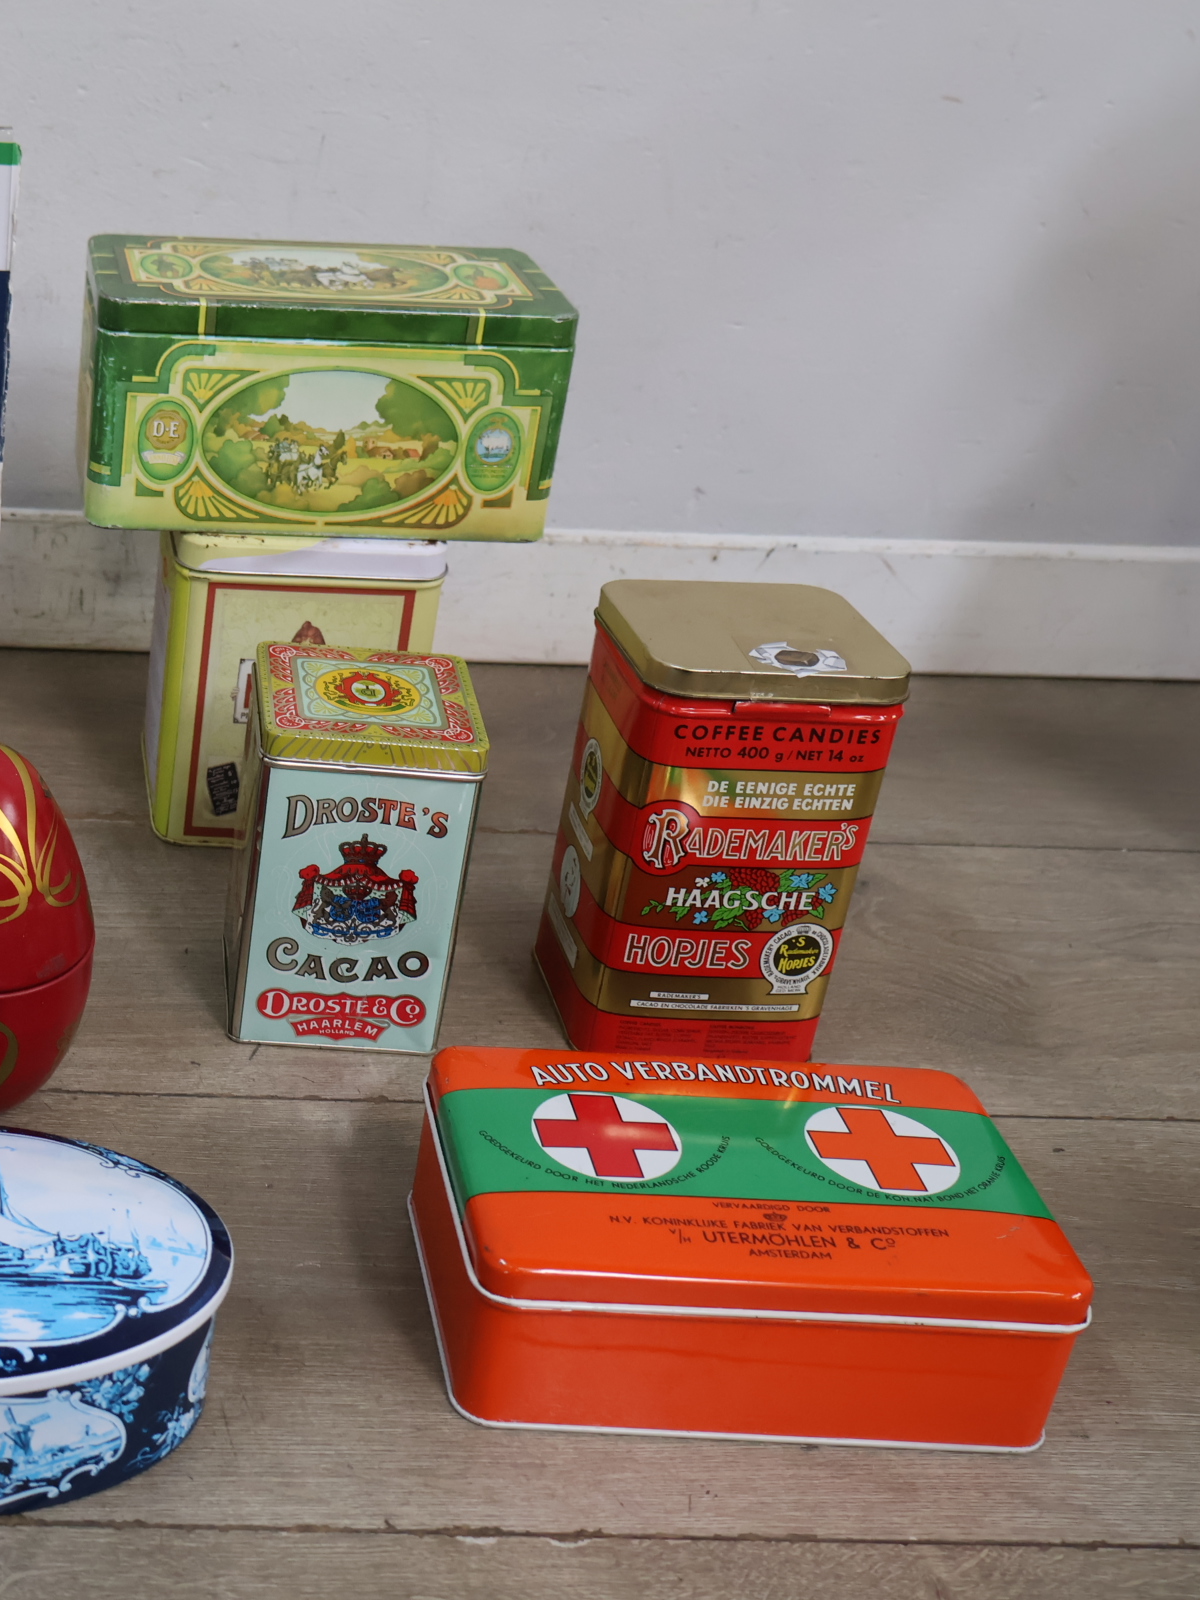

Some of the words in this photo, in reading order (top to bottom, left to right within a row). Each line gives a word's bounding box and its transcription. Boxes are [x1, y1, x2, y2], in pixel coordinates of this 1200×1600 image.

[674, 724, 765, 741] COFFEE
[772, 727, 881, 744] CANDIES
[685, 746, 732, 758] NETTO
[737, 746, 770, 760] 400
[795, 750, 823, 761] NET
[828, 750, 844, 762] 14
[849, 755, 865, 763] oz
[707, 781, 730, 793] DE
[735, 781, 798, 796] EENIGE
[803, 783, 857, 797] ECHTE
[702, 795, 729, 808] DIE
[734, 796, 789, 811] EINZIG
[792, 797, 854, 812] ECHTEN
[281, 794, 449, 839] DROSTE'S
[665, 887, 817, 911] HAAGSCHE
[266, 937, 430, 983] CACAO
[623, 933, 752, 970] HOPJES
[778, 956, 816, 974] HOPJES
[297, 1018, 379, 1037] HAARLEM
[319, 1028, 355, 1036] HOLLAND
[530, 1061, 610, 1086] AUTO
[609, 1061, 902, 1104] VERBANDTROMMEL
[479, 1130, 541, 1170] GOEDGEKEURD
[545, 1168, 579, 1182] DOOR
[585, 1178, 605, 1187] HET
[611, 1171, 697, 1190] NEDERLANDSCHE
[696, 1153, 722, 1173] ROODE
[755, 1136, 826, 1182] GOEDGEKEURD
[828, 1179, 863, 1195] DOOR
[866, 1191, 880, 1199] DE
[936, 1191, 965, 1203] BOND
[712, 1201, 790, 1212] VERVAARDIGD
[797, 1204, 832, 1213] DOOR
[642, 1216, 728, 1229] KONINKLIJKE
[734, 1220, 787, 1231] FABRIEK
[792, 1223, 823, 1233] VAN
[828, 1224, 950, 1238] VERBANDSTOFFEN
[702, 1230, 838, 1248] UTERMÖHLEN
[846, 1236, 861, 1249] &
[748, 1248, 832, 1260] AMSTERDAM
